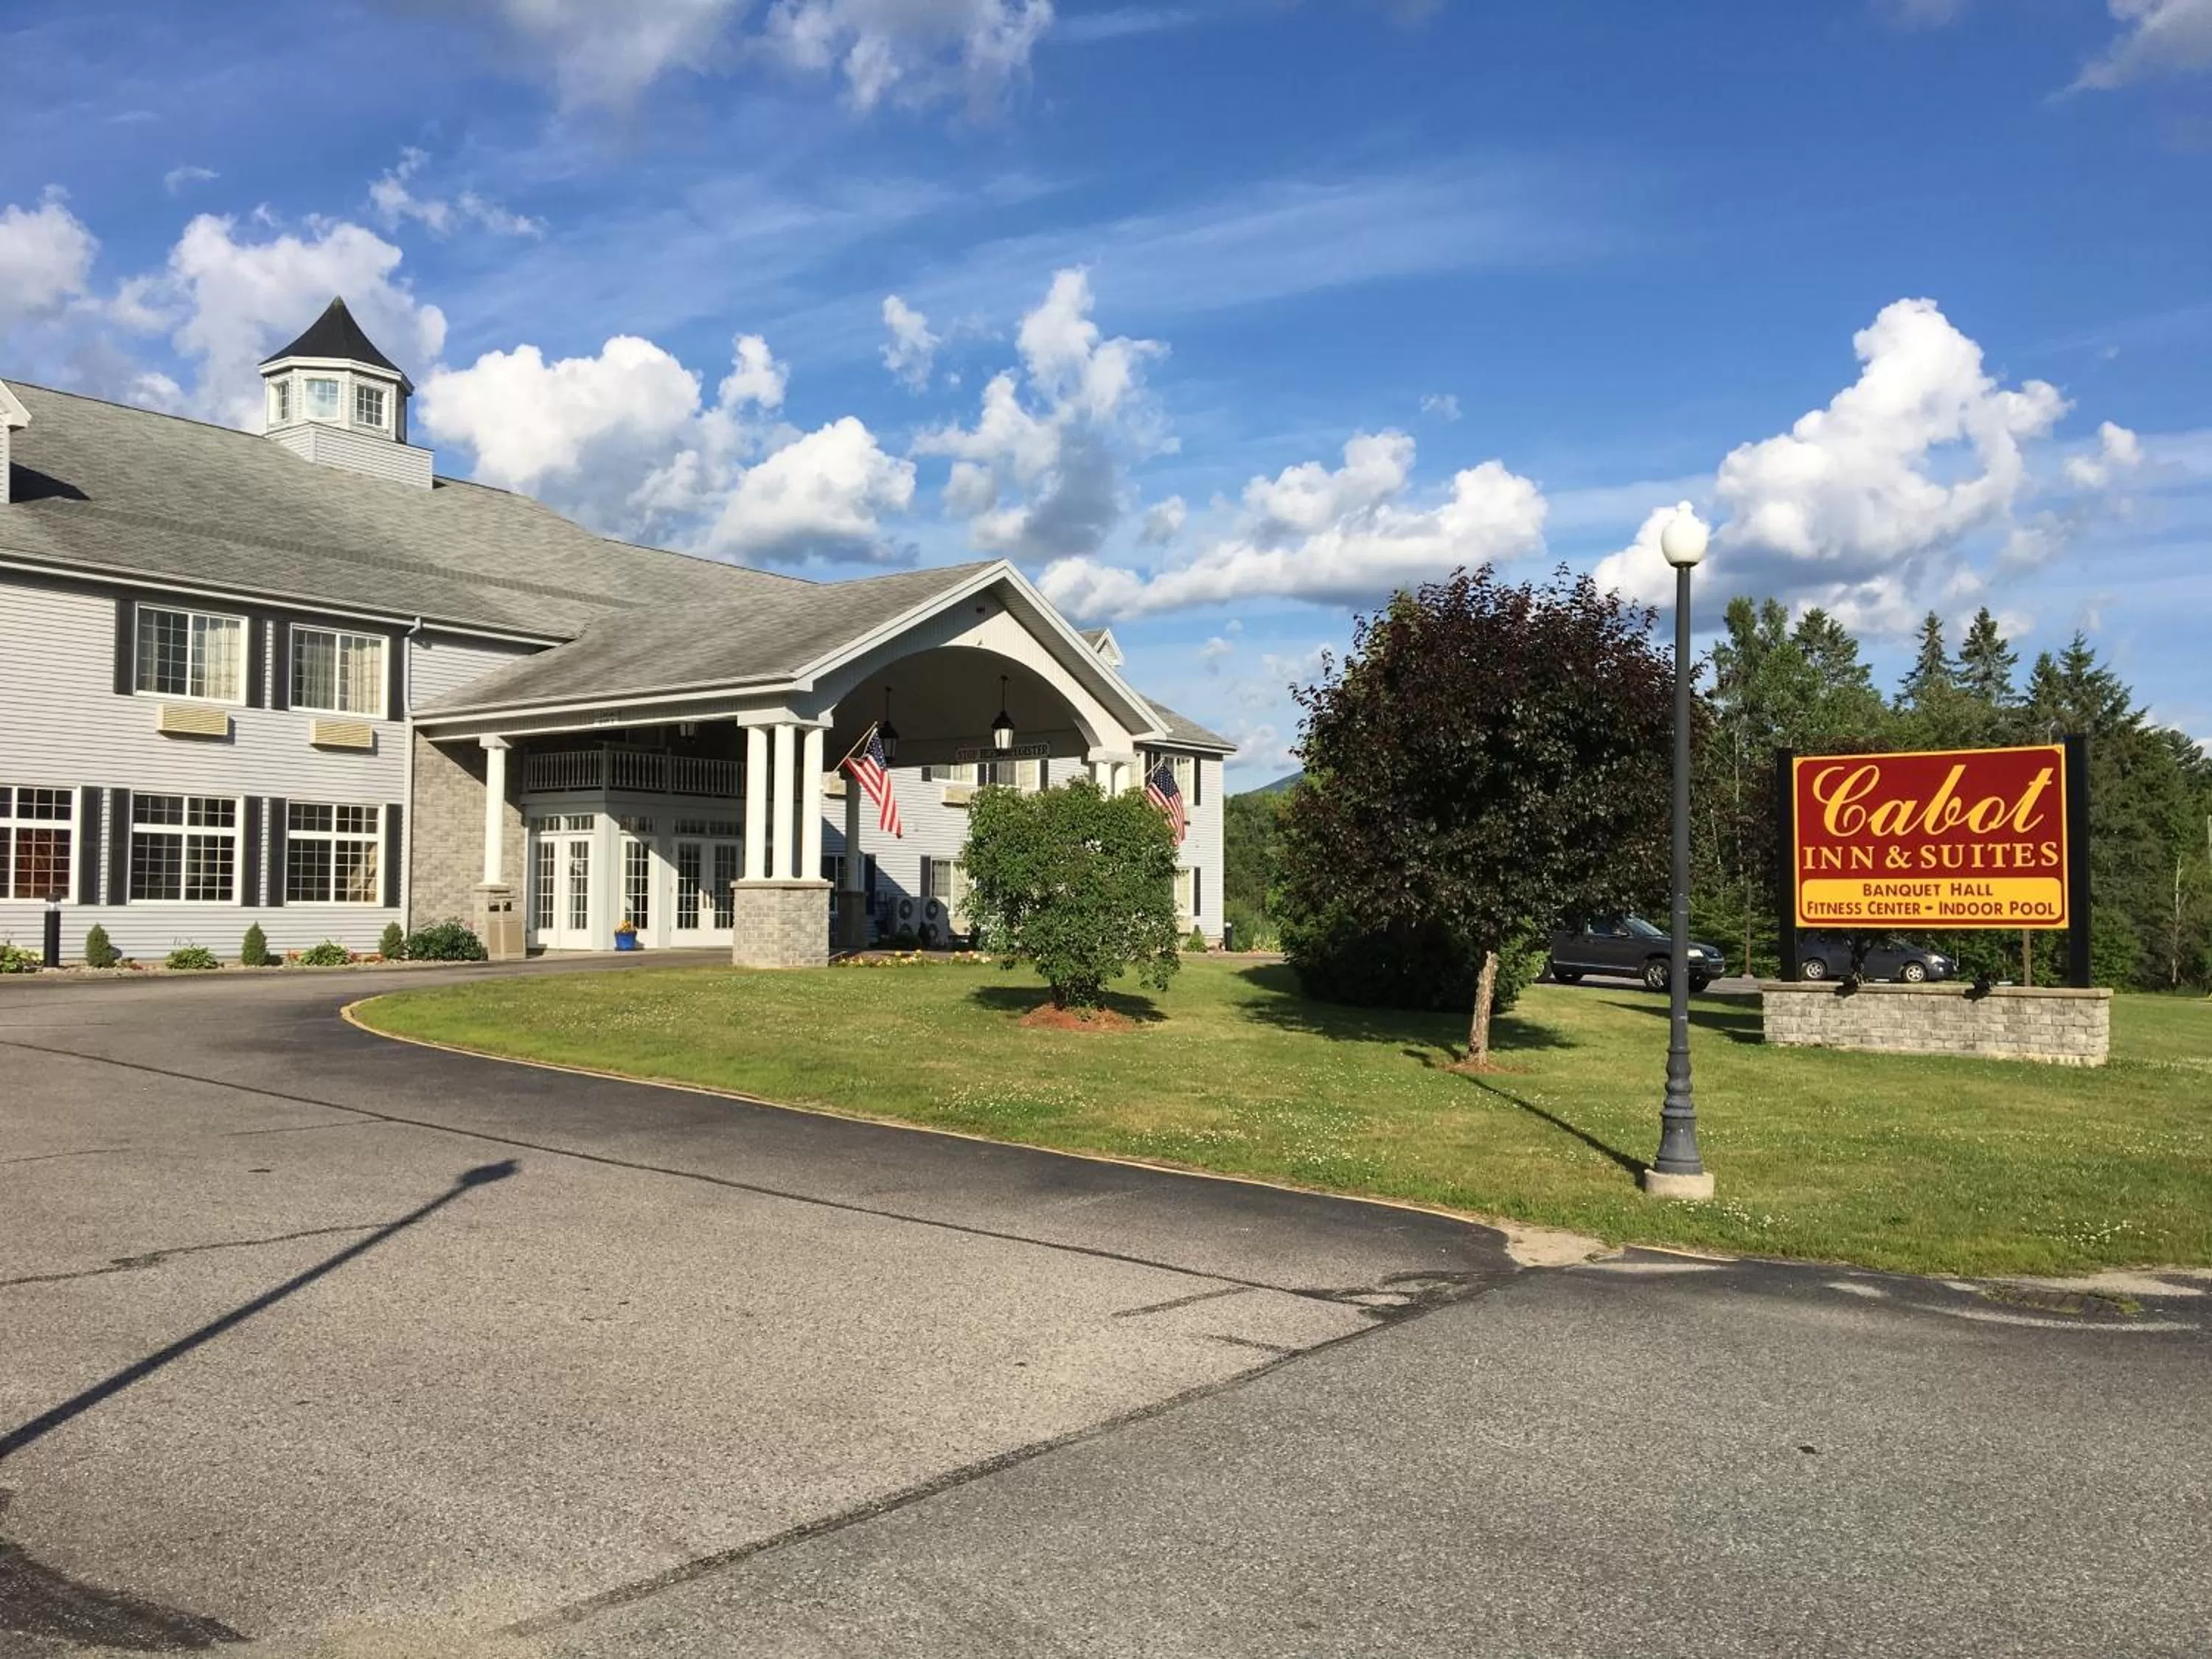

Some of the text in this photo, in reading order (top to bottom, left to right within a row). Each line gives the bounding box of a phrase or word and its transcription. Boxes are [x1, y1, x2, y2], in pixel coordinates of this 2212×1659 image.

[1812, 764, 2053, 837] Cabot
[1803, 841, 2059, 869] INN & SUITES
[1863, 883, 1994, 897] BANQUET HALL
[1806, 900, 2056, 916] FITNESS CENTER INDOOR POOL
